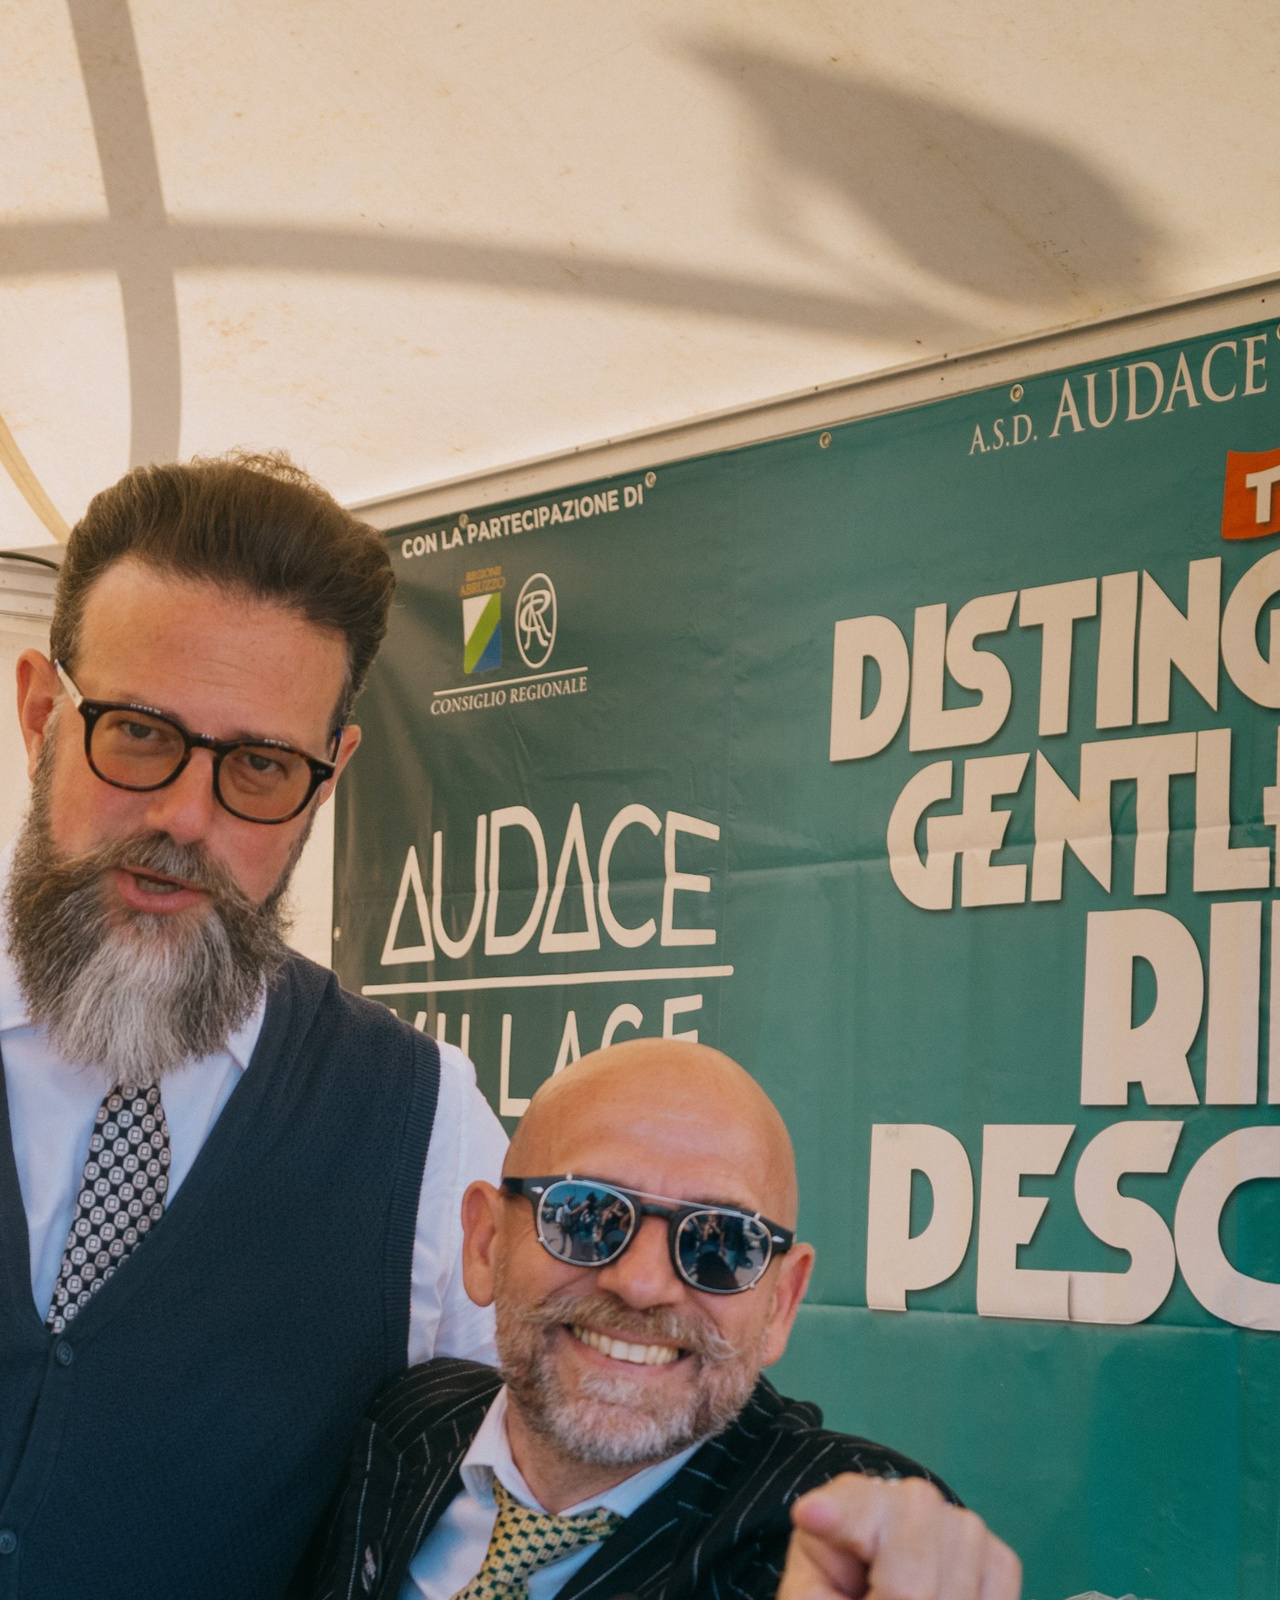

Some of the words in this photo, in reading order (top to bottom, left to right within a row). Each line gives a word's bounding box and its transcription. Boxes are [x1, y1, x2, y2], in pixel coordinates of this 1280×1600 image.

[968, 413, 1038, 456] A.S.D.
[1049, 333, 1269, 439] AUDACE
[402, 533, 438, 559] CON
[441, 527, 464, 550] LA
[467, 490, 619, 544] PARTECIPAZIONE
[624, 484, 644, 508] DI
[460, 577, 506, 597] ABRUZZO
[430, 690, 507, 716] CONSIGLIO
[509, 676, 588, 704] REGIONALE
[829, 552, 1280, 763] DISTING
[380, 802, 720, 965] AUDACE
[886, 726, 1280, 911] GENTL
[1080, 899, 1280, 1106] RI
[866, 1119, 1280, 1332] PESC
